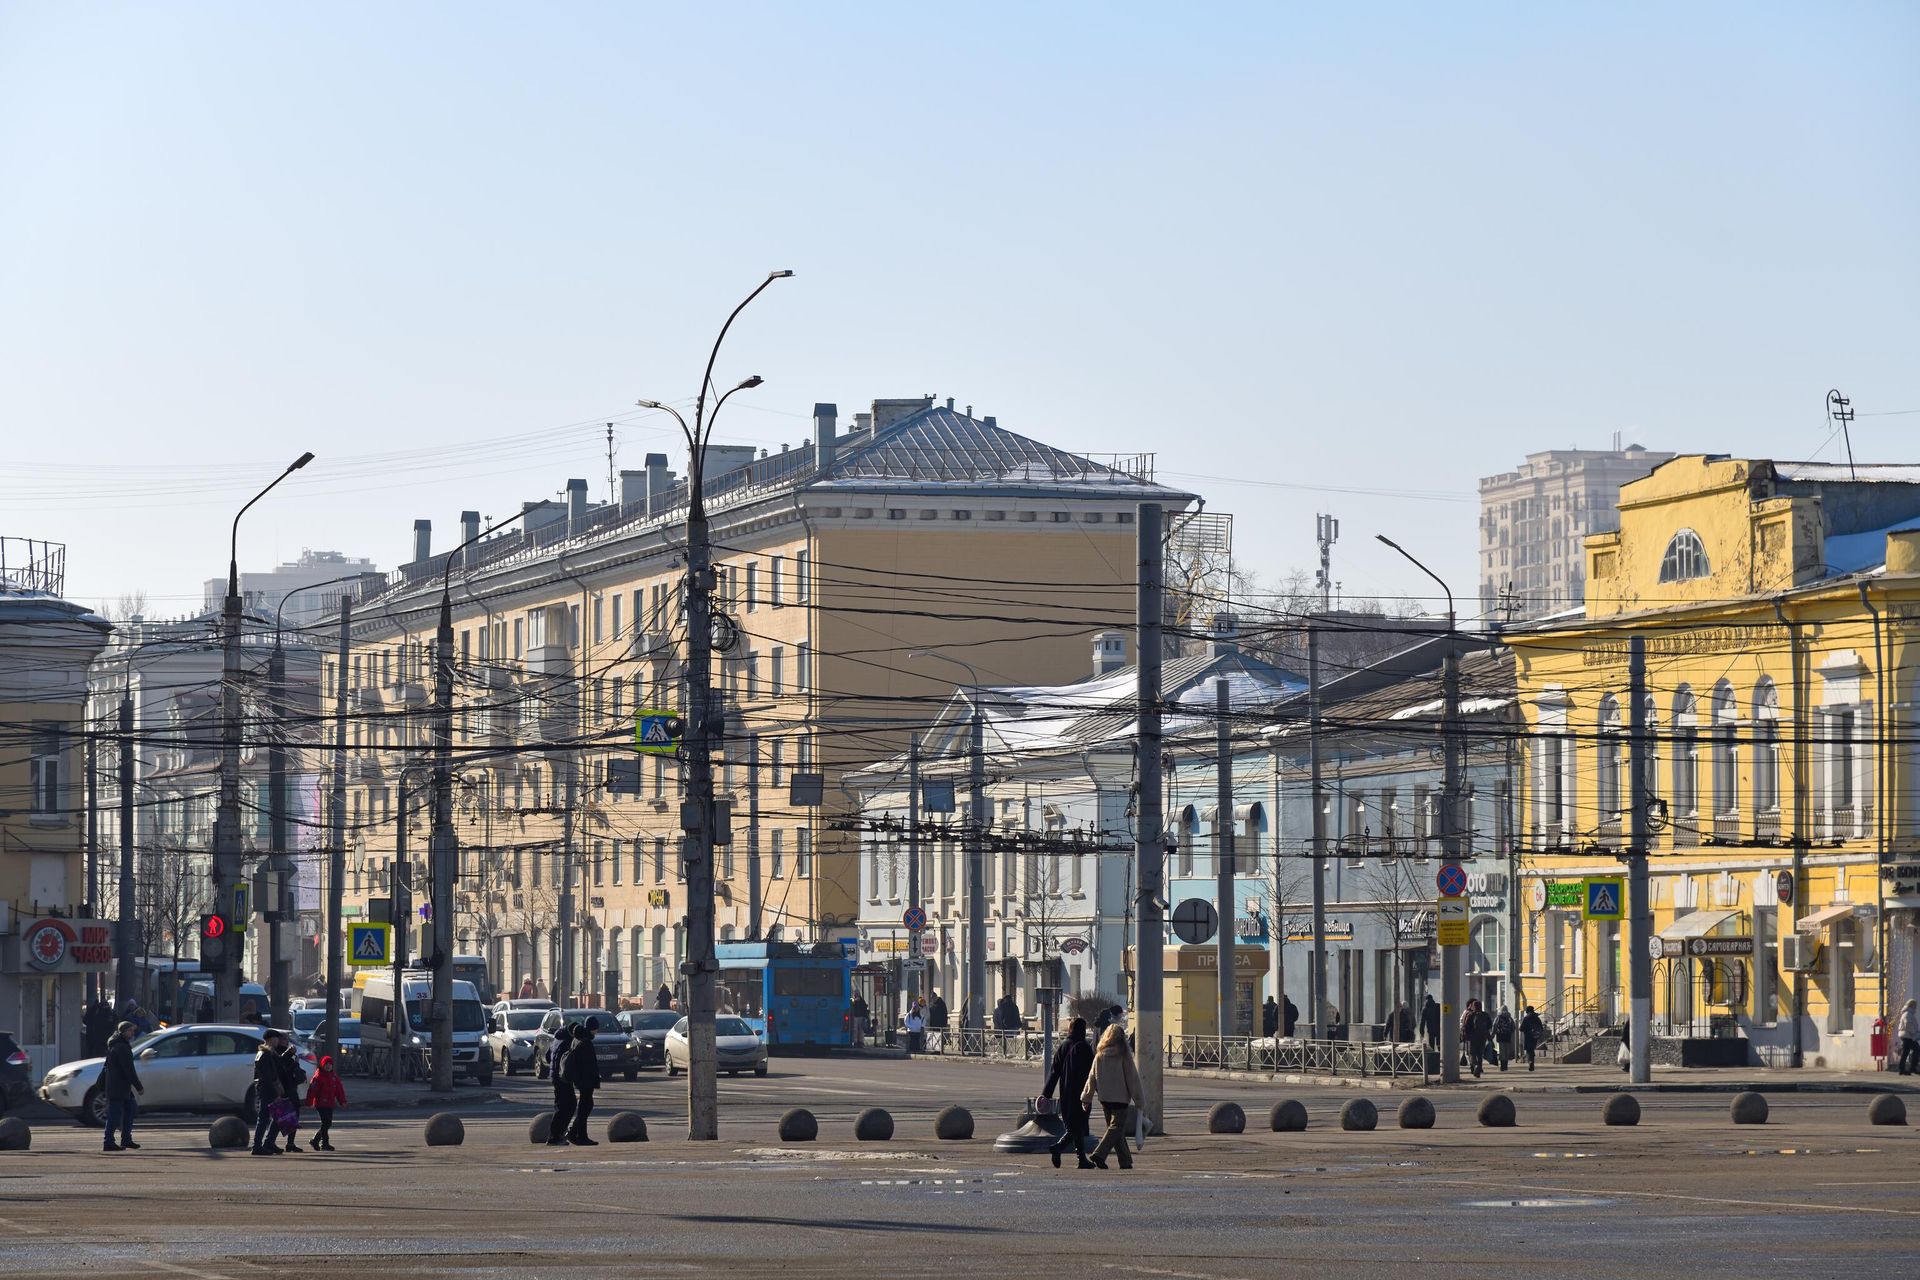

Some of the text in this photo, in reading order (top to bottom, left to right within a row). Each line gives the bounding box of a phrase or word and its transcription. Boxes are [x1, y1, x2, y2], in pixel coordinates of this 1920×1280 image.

[82, 927, 108, 944] МИР
[1707, 942, 1751, 952] САМОВАРНАЯ
[1198, 954, 1251, 966] ПРСА
